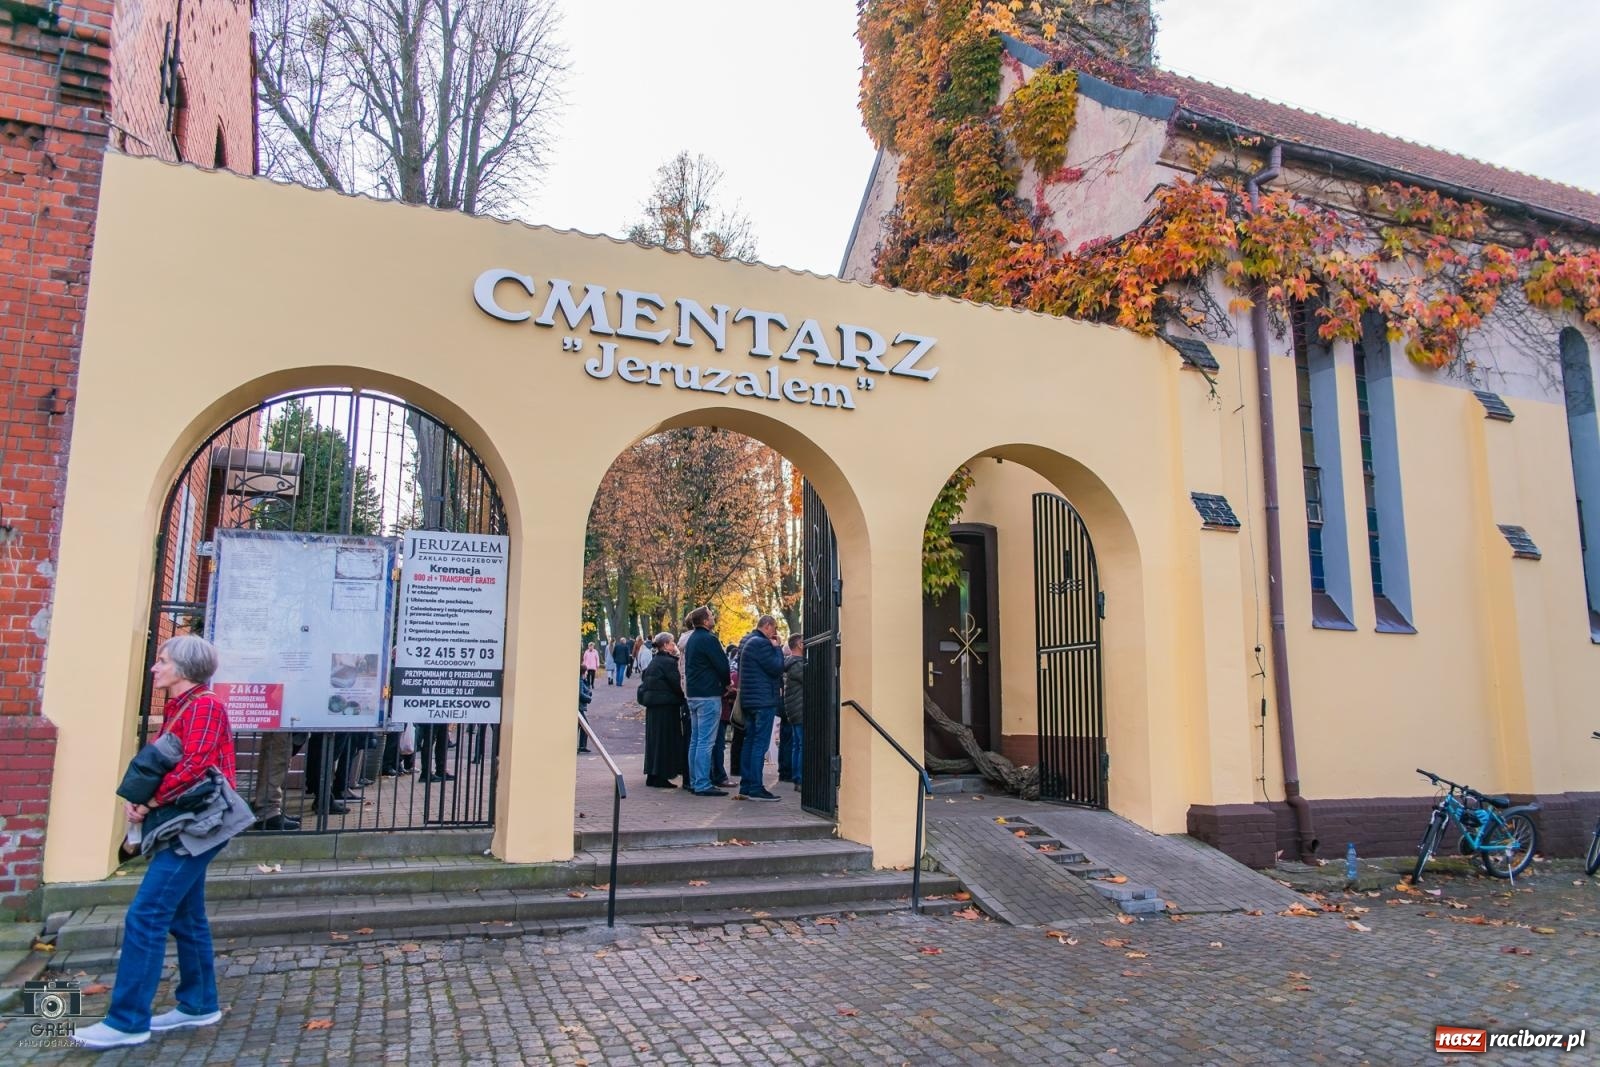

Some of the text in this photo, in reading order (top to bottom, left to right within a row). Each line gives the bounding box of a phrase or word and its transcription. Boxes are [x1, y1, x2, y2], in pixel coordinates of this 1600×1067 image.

[473, 268, 940, 381] CMENTARZ
[410, 538, 502, 559] JERUZALEM
[430, 564, 480, 576] Kremacja
[440, 575, 473, 583] TRANSPORT
[448, 607, 492, 615] międzynarodowy
[415, 647, 494, 659] 32 415 57 03
[405, 670, 448, 678] PRZYPOMINAMY
[454, 670, 492, 679] PRZEDŁUŻANIU
[423, 678, 458, 686] POCHÓWKÓW
[230, 684, 266, 694] ZAKAZ
[404, 699, 490, 708] KOMPLEKSOWO
[428, 709, 467, 718] TANIEJ!
